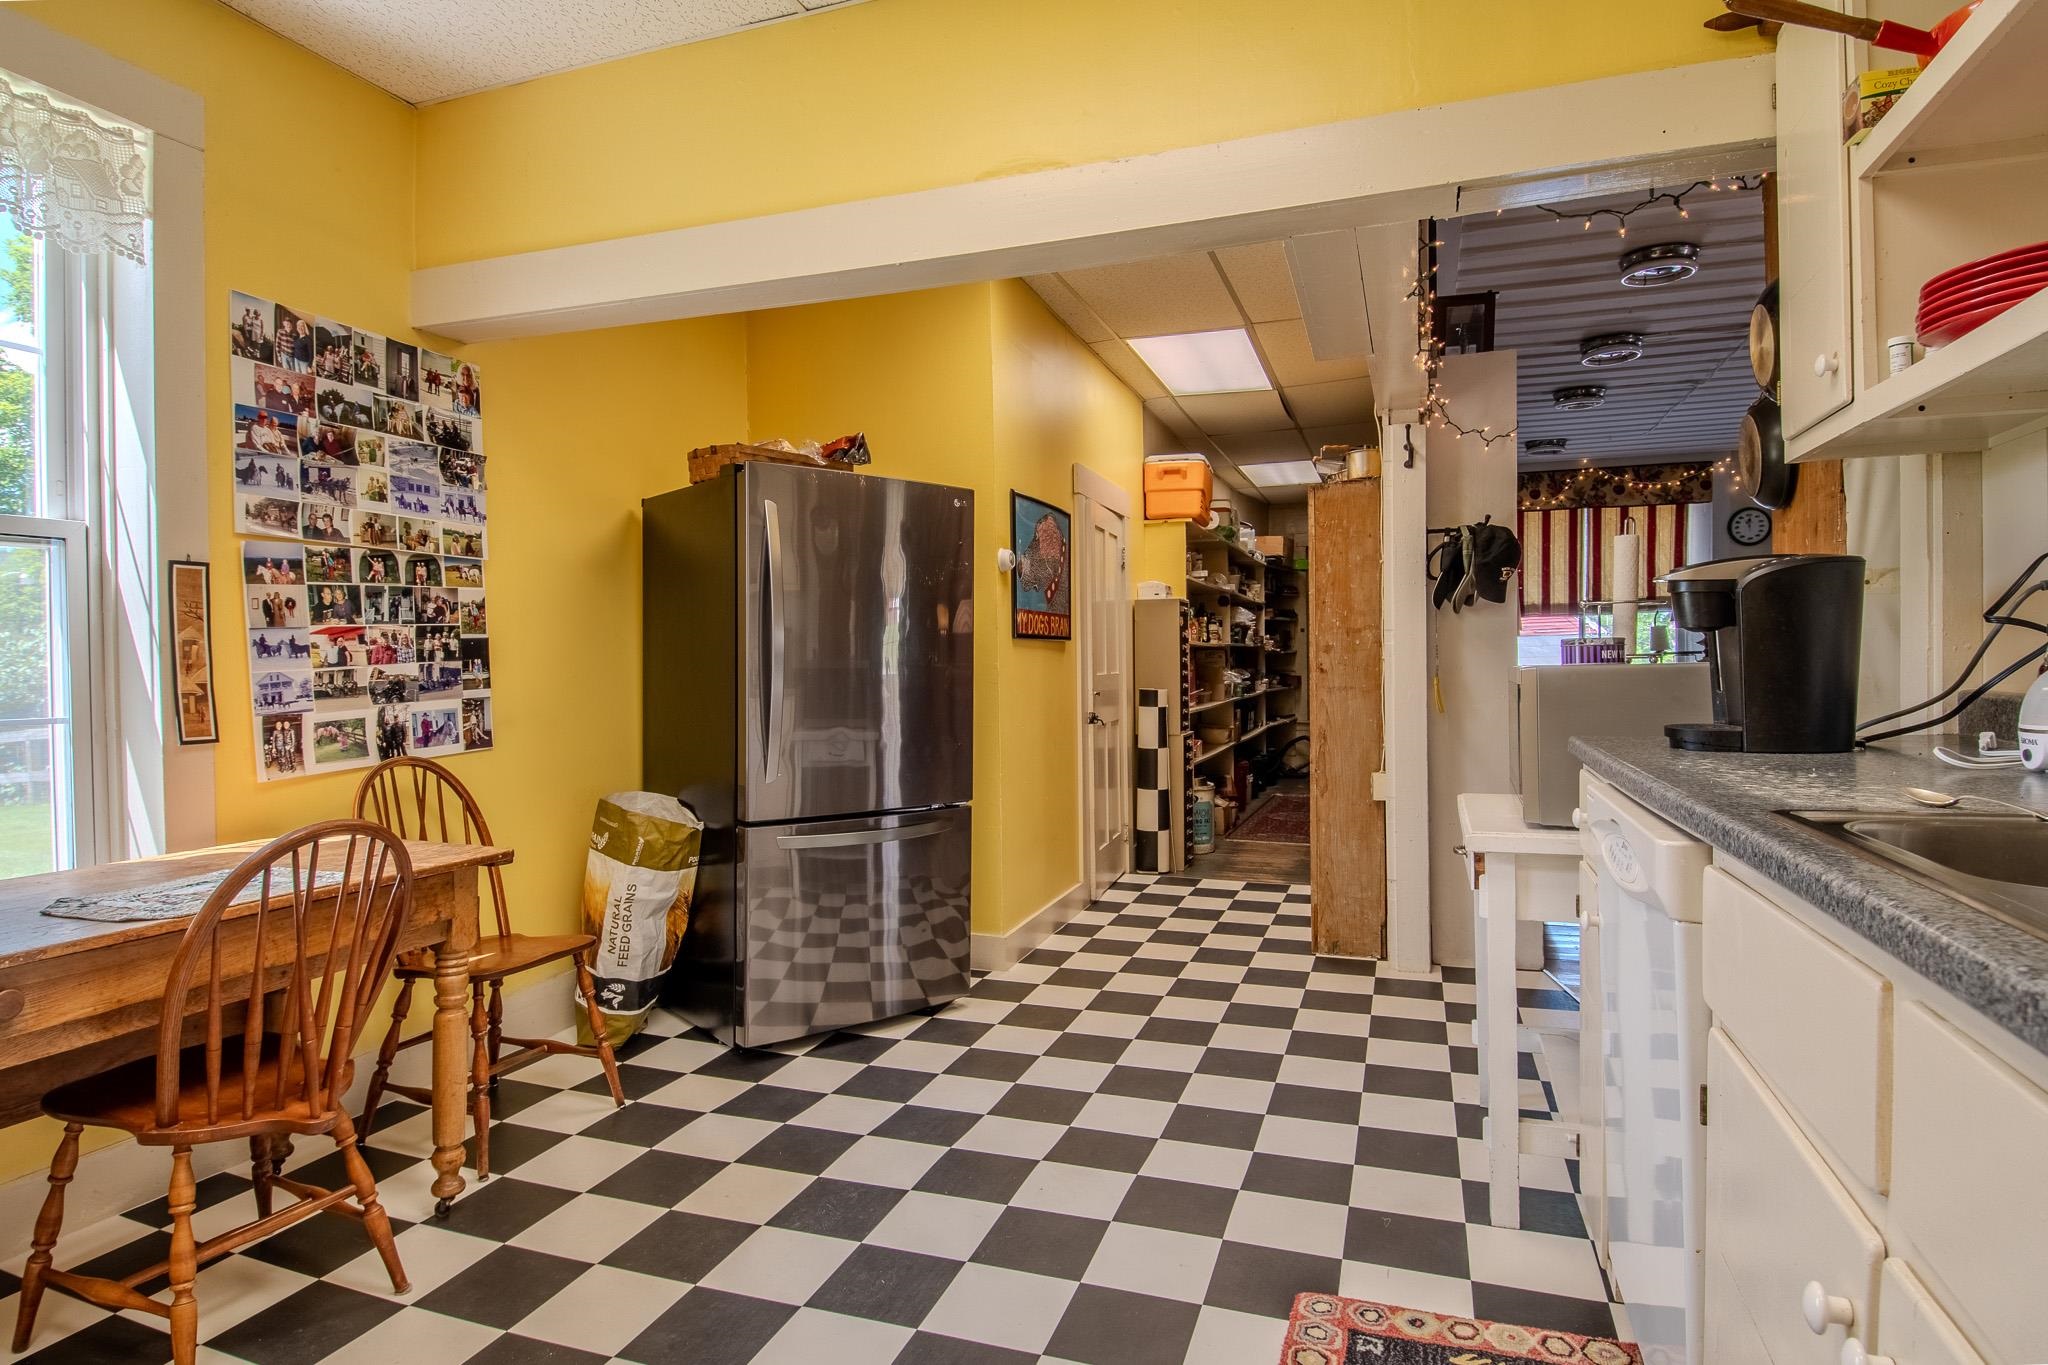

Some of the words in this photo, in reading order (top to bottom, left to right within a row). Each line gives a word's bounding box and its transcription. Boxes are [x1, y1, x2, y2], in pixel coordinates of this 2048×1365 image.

[1873, 80, 1897, 90] Cozy
[1899, 76, 1915, 87] Ch
[1028, 613, 1049, 636] DOGS
[1050, 616, 1070, 637] BRAIN
[1601, 650, 1618, 659] NEW
[622, 883, 637, 933] GRAINS
[607, 896, 622, 954] NATURAL
[617, 935, 631, 967] FEED
